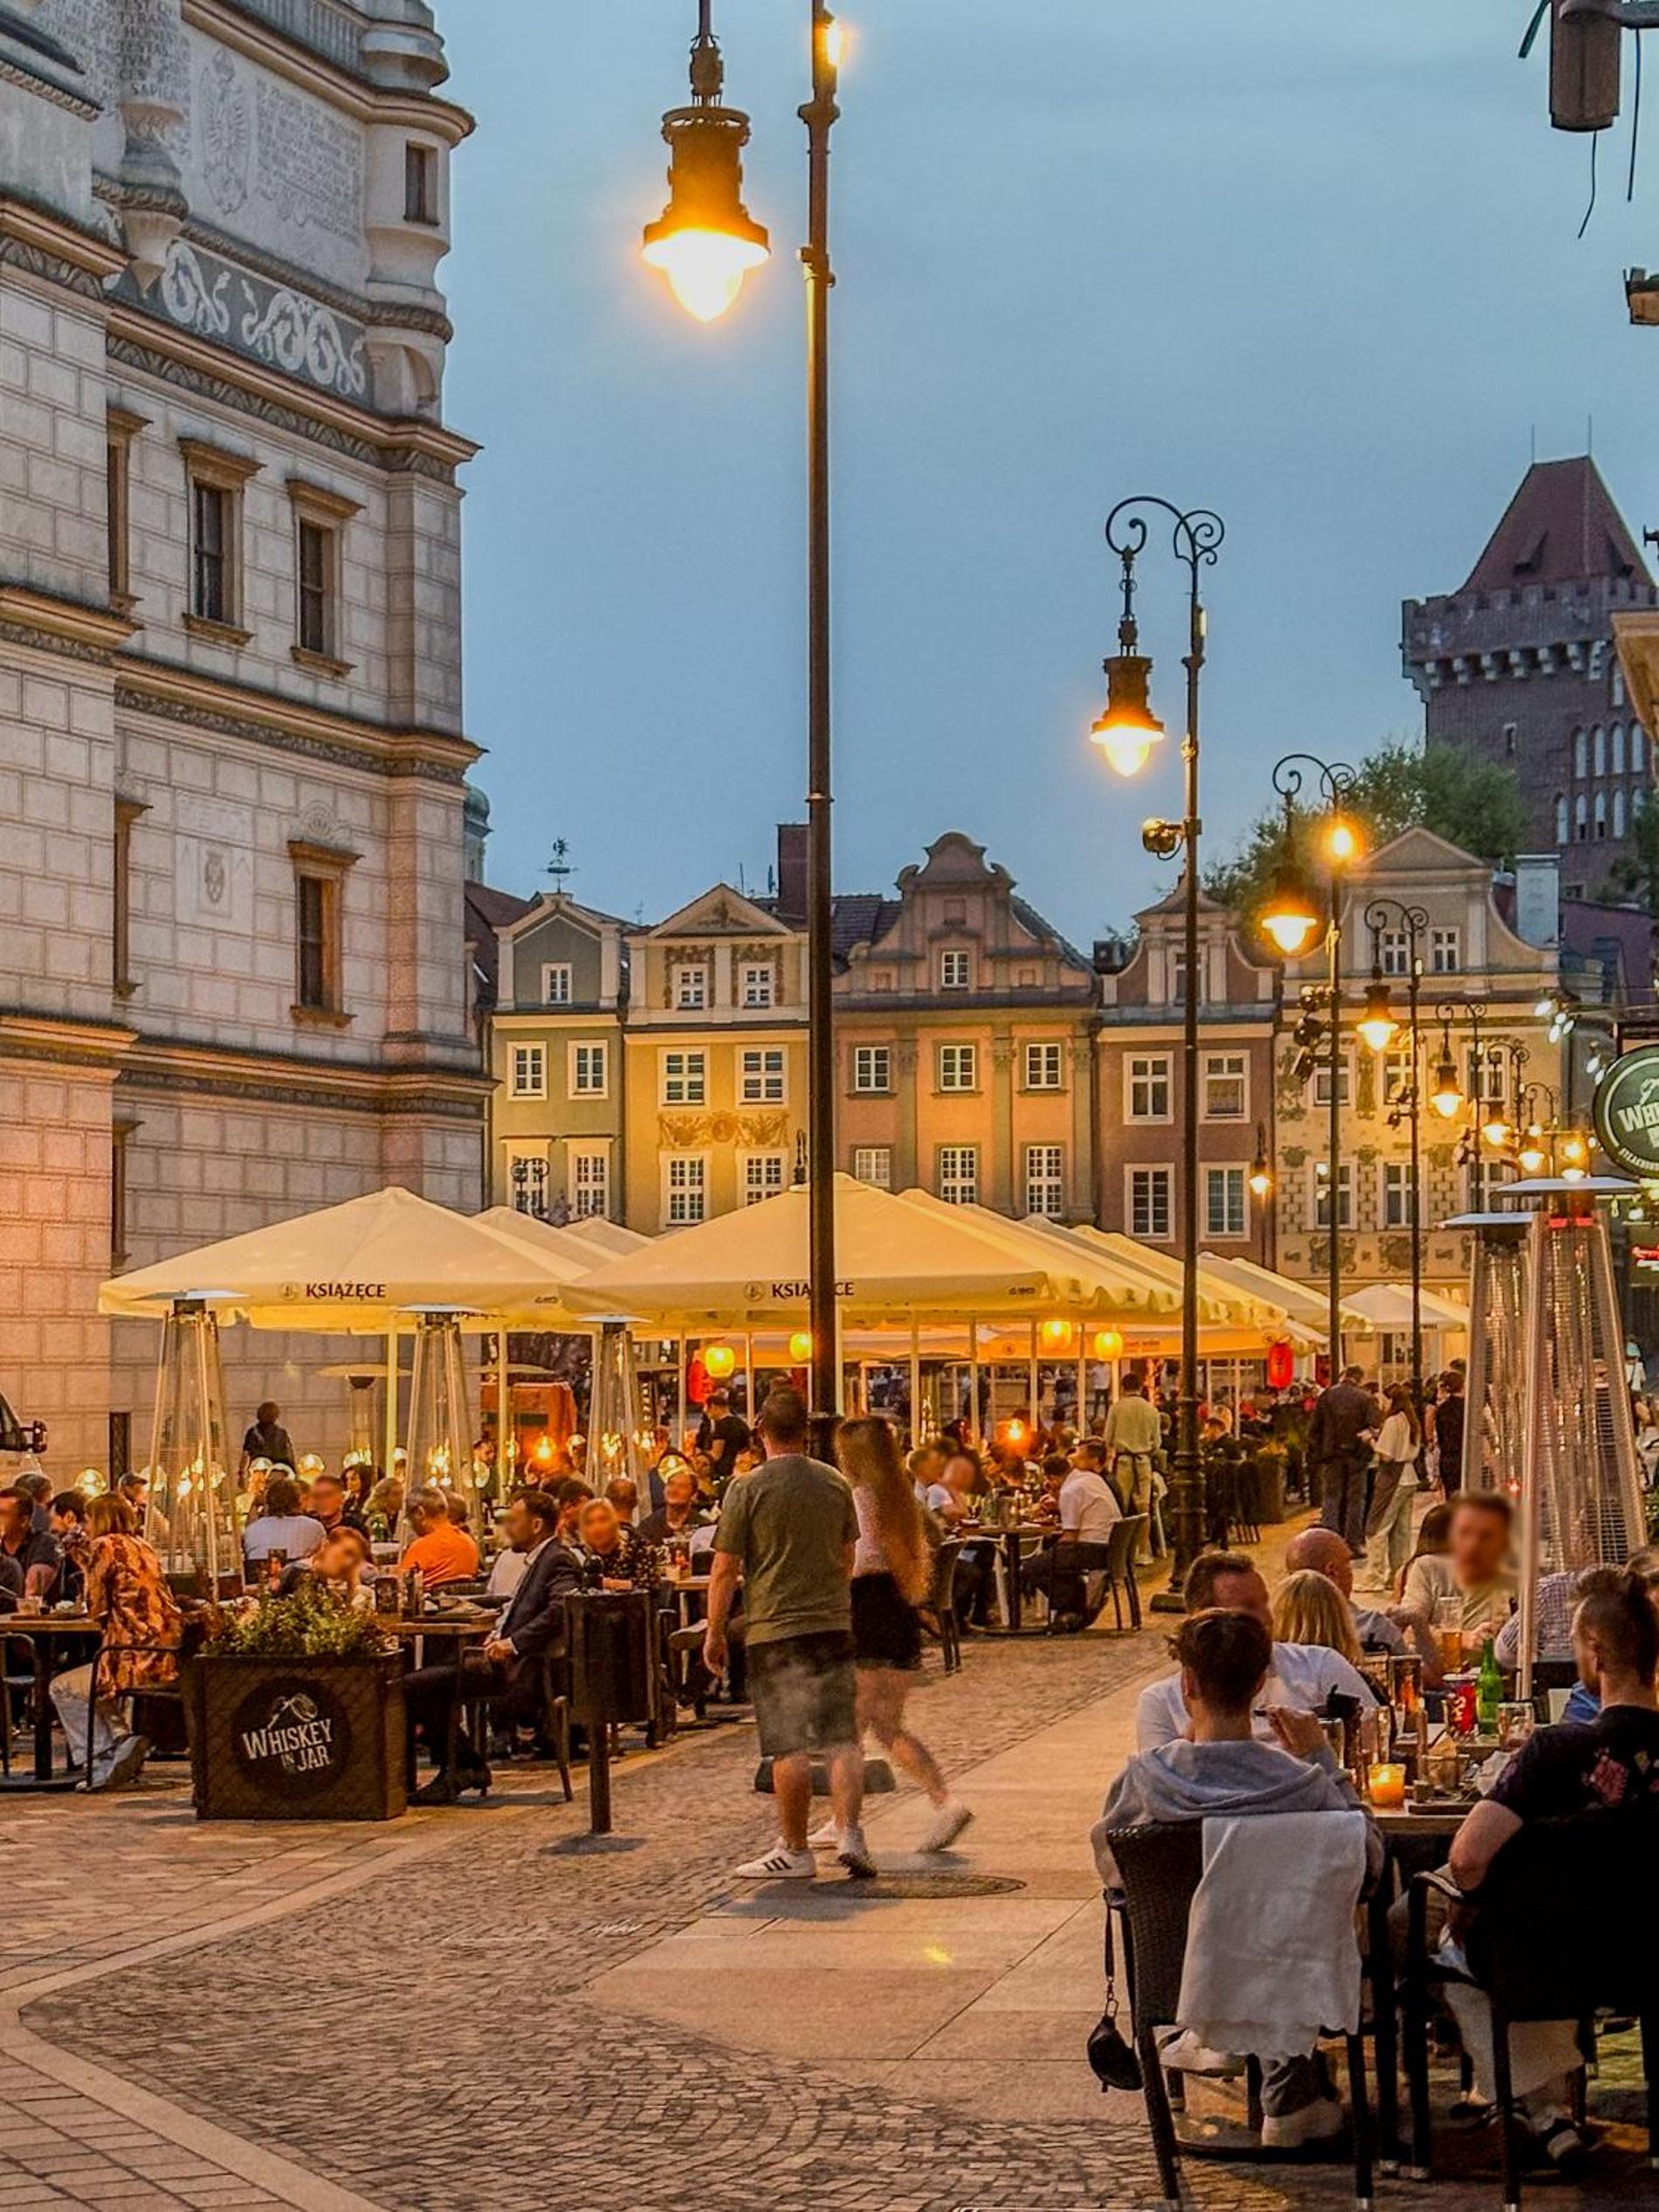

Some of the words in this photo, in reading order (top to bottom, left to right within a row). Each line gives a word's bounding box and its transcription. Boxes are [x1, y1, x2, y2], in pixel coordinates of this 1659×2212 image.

[306, 1280, 387, 1300] KSIĄŻĘCE
[242, 1718, 333, 1760] WHISKEY
[297, 1746, 331, 1771] JAR
